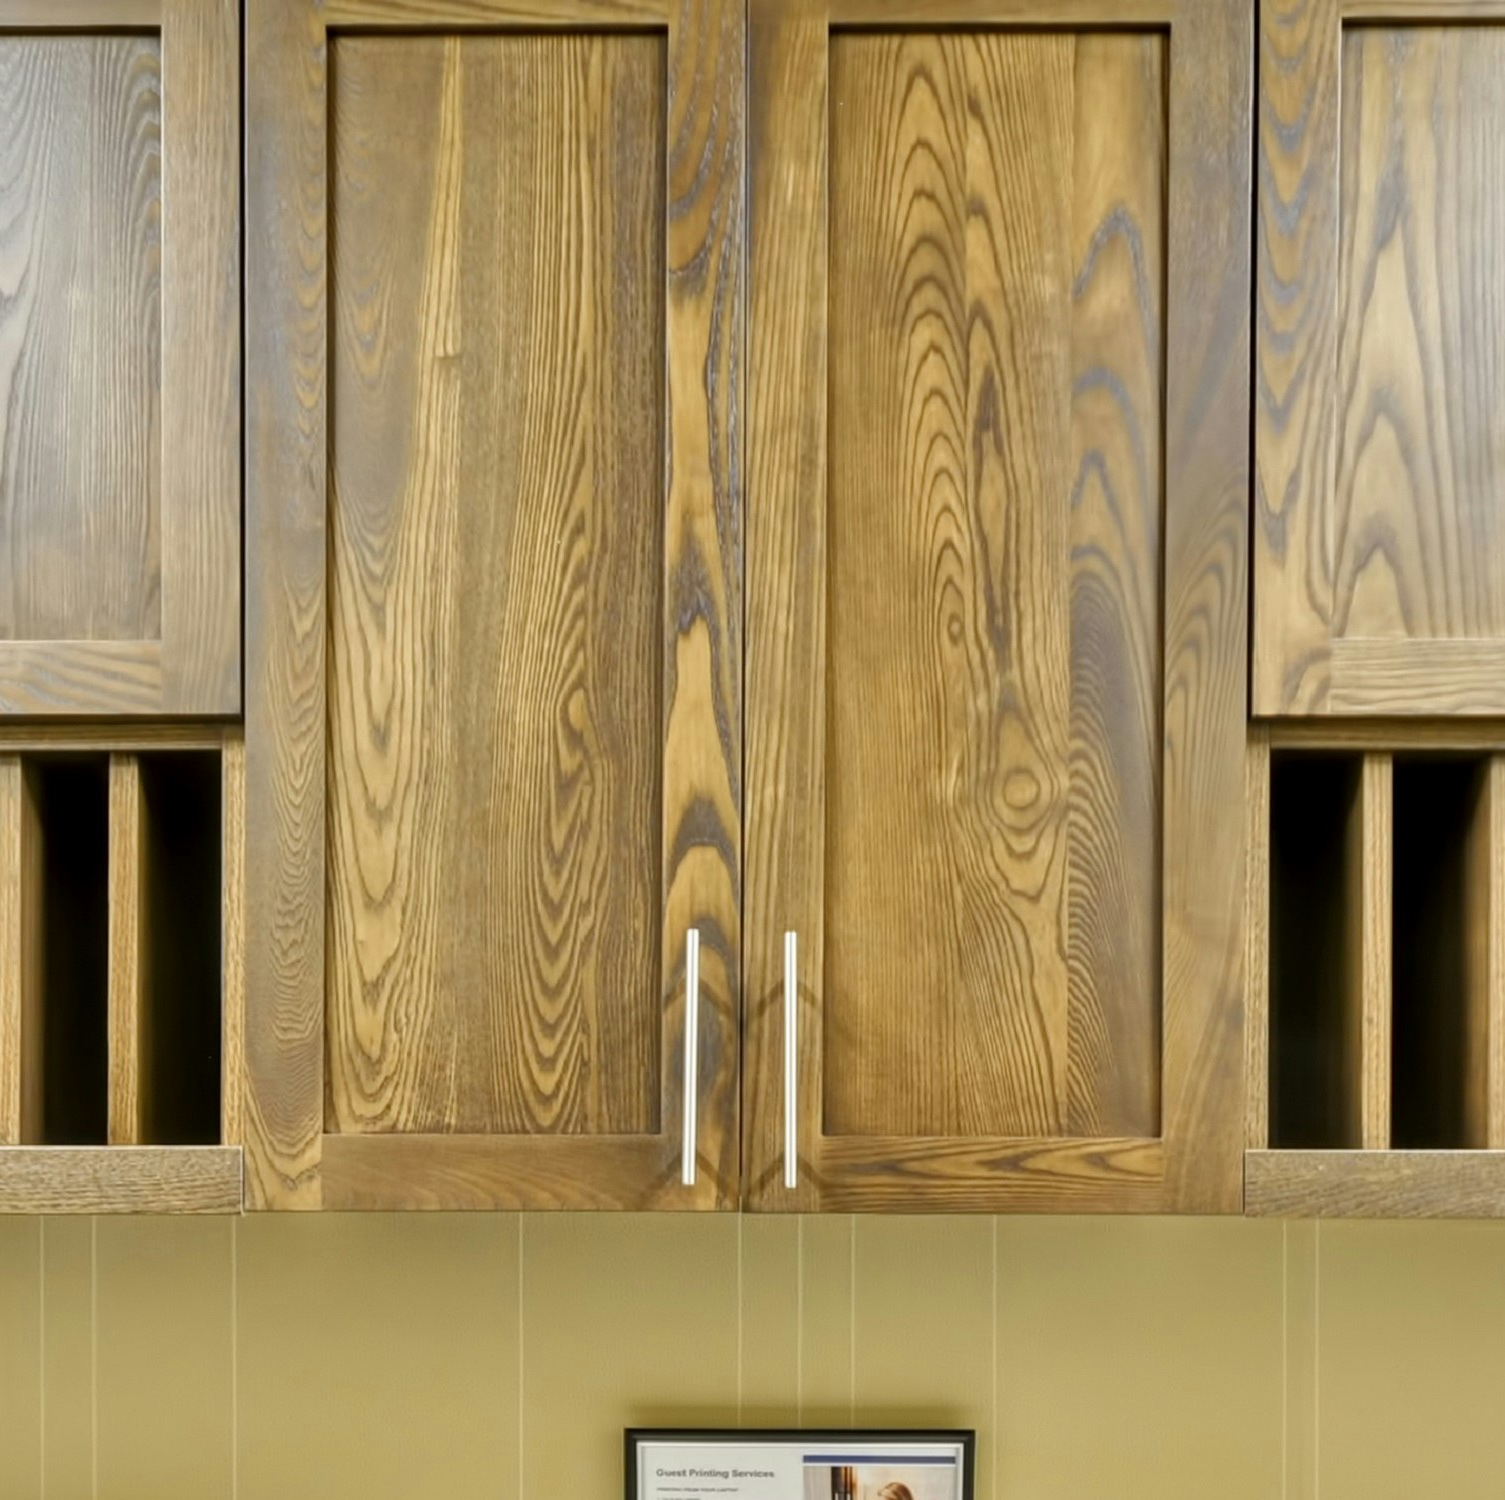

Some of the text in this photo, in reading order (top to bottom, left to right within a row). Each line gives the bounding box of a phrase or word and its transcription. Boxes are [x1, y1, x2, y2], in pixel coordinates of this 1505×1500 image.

[655, 1468, 775, 1479] Guest Printing Services
